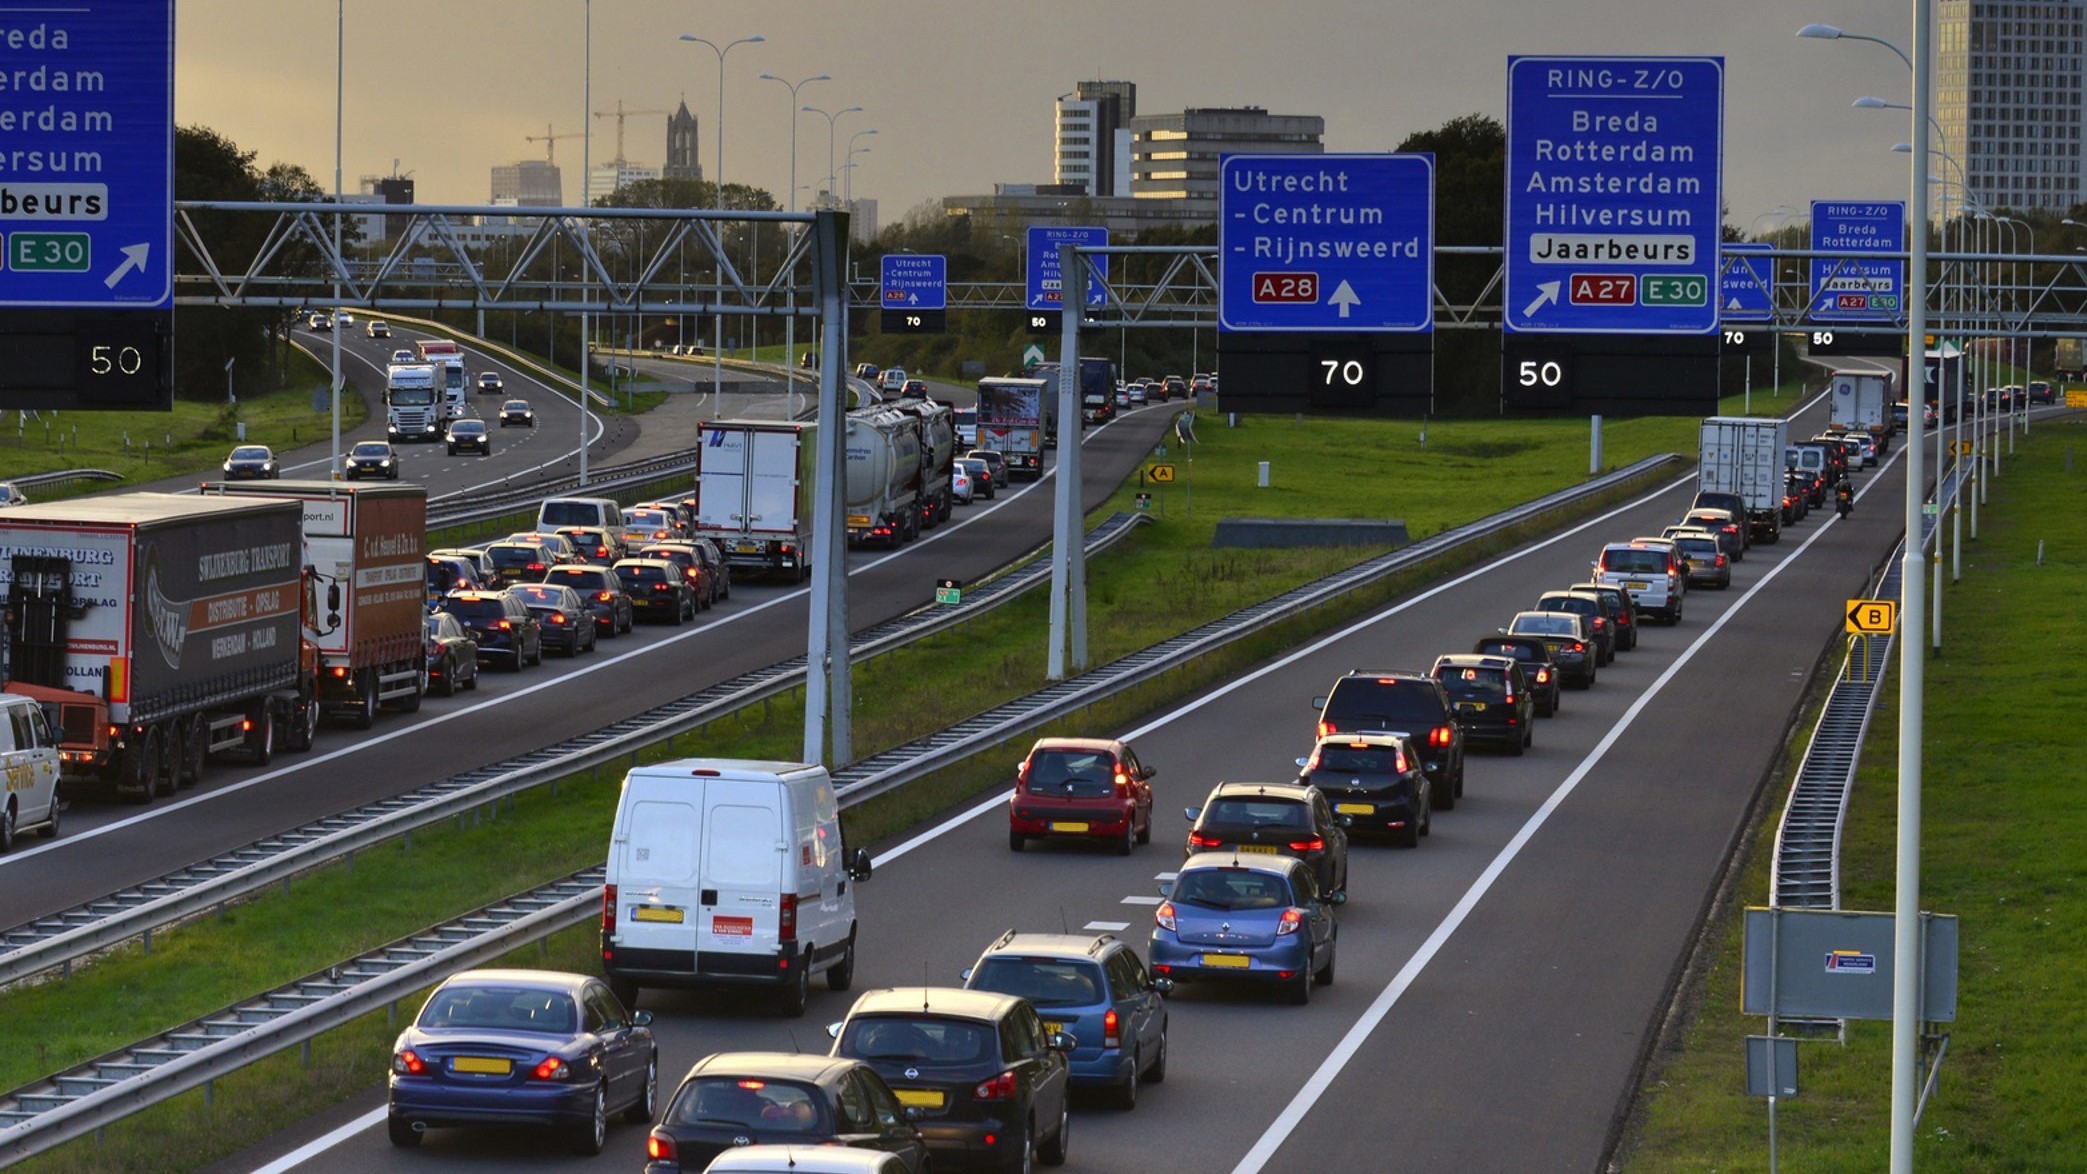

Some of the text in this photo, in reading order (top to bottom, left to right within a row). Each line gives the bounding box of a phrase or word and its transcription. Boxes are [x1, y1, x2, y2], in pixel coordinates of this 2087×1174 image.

[1572, 110, 1658, 132] Breda
[1536, 139, 1694, 162] Rotterdam
[1234, 170, 1349, 192] Utrecht
[1526, 171, 1701, 194] Amsterdam
[1536, 203, 1692, 226] Hilversum
[1838, 224, 1876, 235] Breda
[1536, 238, 1690, 261] Jaarbeurs
[1823, 237, 1892, 248] Rotterdam
[895, 259, 932, 268] Utrecht
[906, 316, 921, 327] 70
[1031, 317, 1046, 327] 50
[1724, 331, 1744, 345] 70
[1813, 332, 1834, 345] 50
[91, 346, 142, 375] 50
[1320, 360, 1364, 385] 70
[1519, 361, 1562, 387] 50
[1159, 468, 1169, 478] A
[1869, 609, 1881, 624] B
